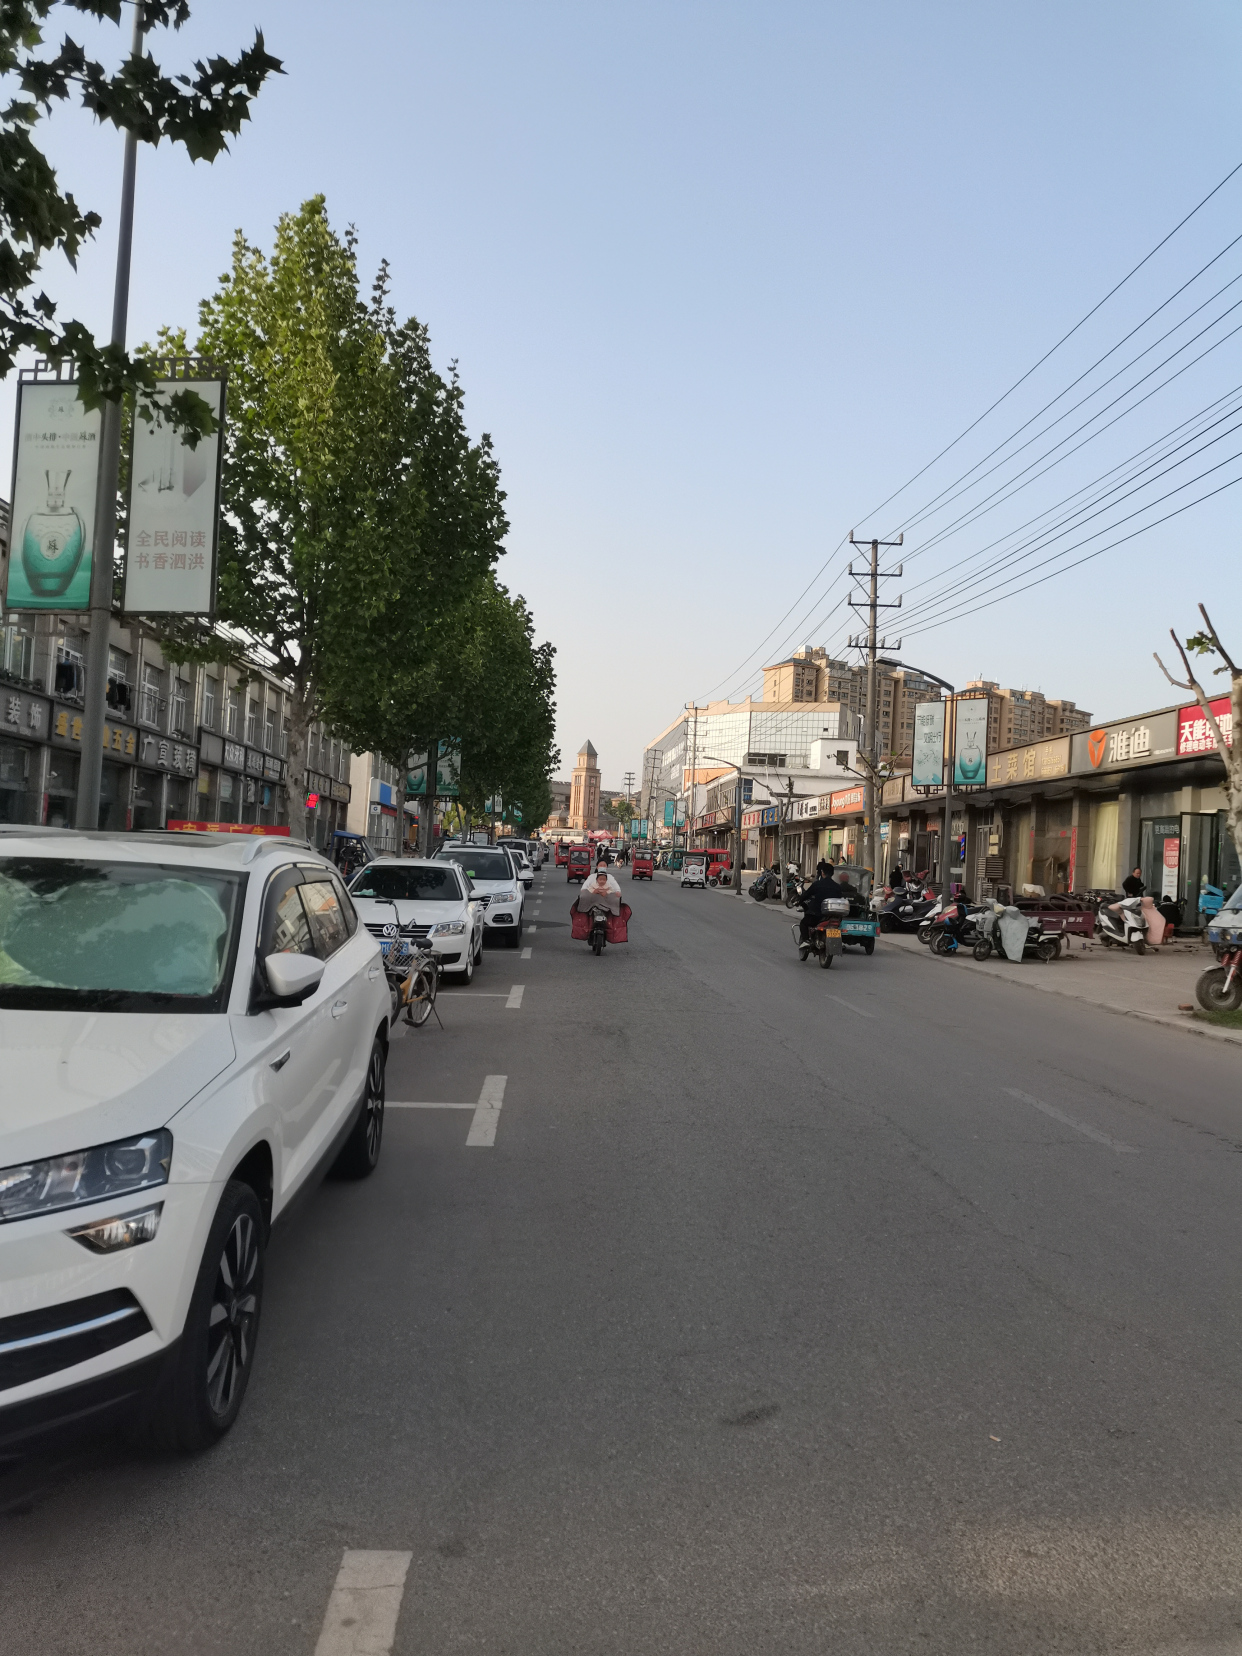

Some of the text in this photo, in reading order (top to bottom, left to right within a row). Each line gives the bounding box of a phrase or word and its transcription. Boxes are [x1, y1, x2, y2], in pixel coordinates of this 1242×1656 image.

[136, 530, 206, 548] 全民阅读
[135, 552, 205, 570] 书香泗洪
[1108, 726, 1150, 763] 雅迪
[990, 749, 1036, 783] 土菜馆
